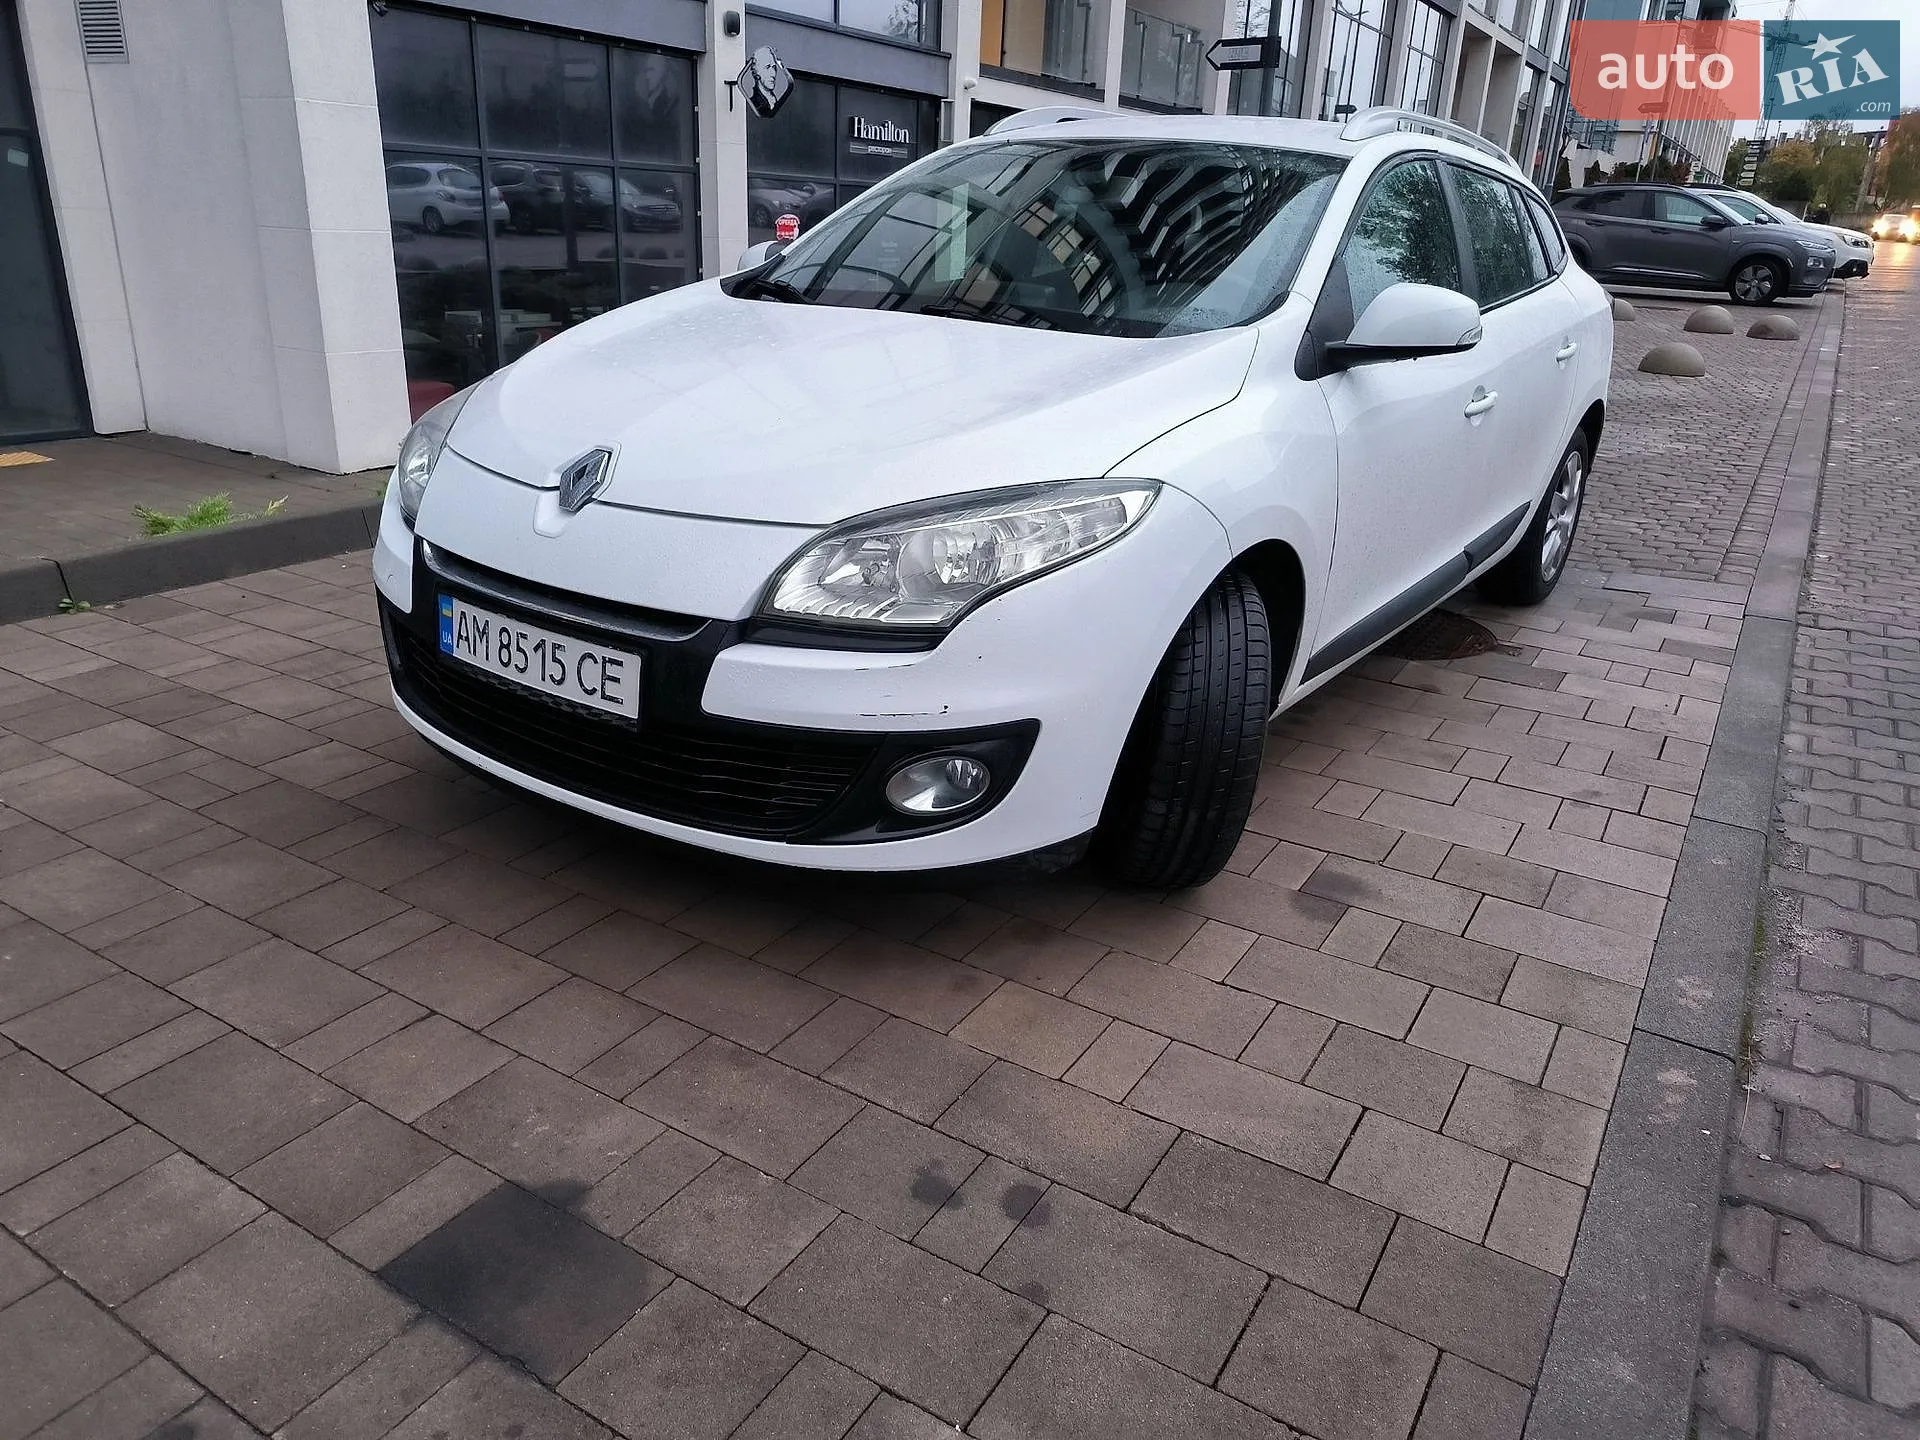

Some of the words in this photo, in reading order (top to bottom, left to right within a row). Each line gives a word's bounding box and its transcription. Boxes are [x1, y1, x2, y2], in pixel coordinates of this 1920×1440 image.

[853, 116, 910, 144] Hamilton
[442, 632, 453, 646] UA
[456, 610, 490, 661] AM
[498, 626, 567, 686] 8515
[576, 651, 624, 705] CE
